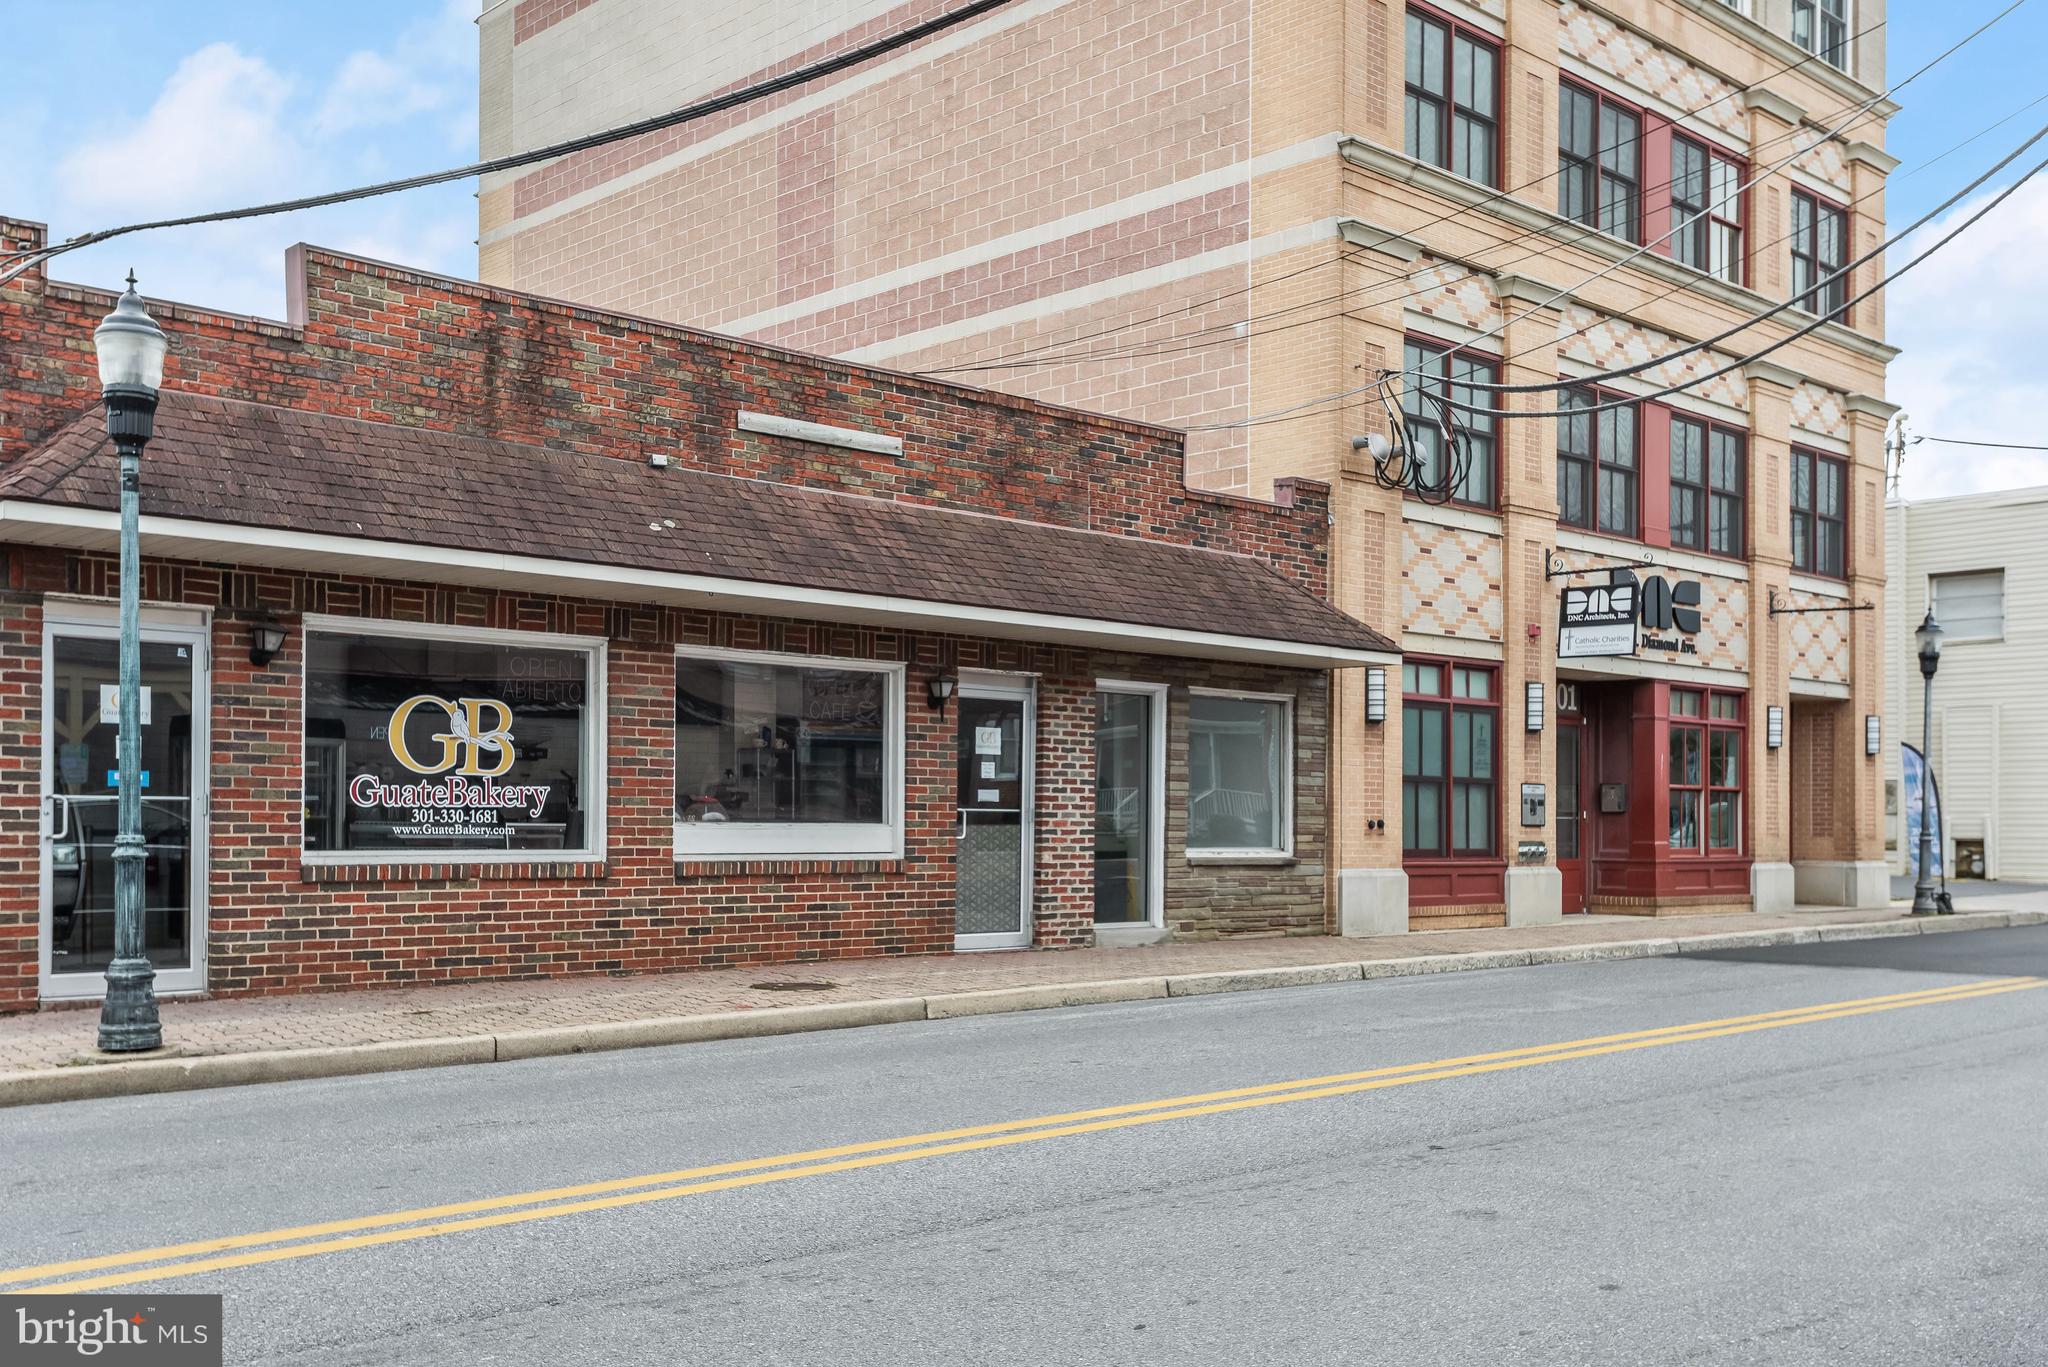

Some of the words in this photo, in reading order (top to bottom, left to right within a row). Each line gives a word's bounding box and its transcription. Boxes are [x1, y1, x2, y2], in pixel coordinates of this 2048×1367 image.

[1567, 614, 1584, 622] DNC
[1584, 613, 1616, 621] Architects,
[1574, 636, 1601, 645] Catholic
[1601, 635, 1630, 643] Charities
[1641, 633, 1679, 652] Diamond
[1680, 640, 1698, 655] Ave.
[510, 656, 572, 680] OPEN
[502, 678, 582, 702] ABIERTO
[809, 698, 851, 721] CAFÉ
[388, 694, 516, 777] GB
[349, 774, 551, 819] GuateBakery
[411, 809, 499, 824] 301-330-1681
[392, 823, 516, 838] www.GuateBakery.com
